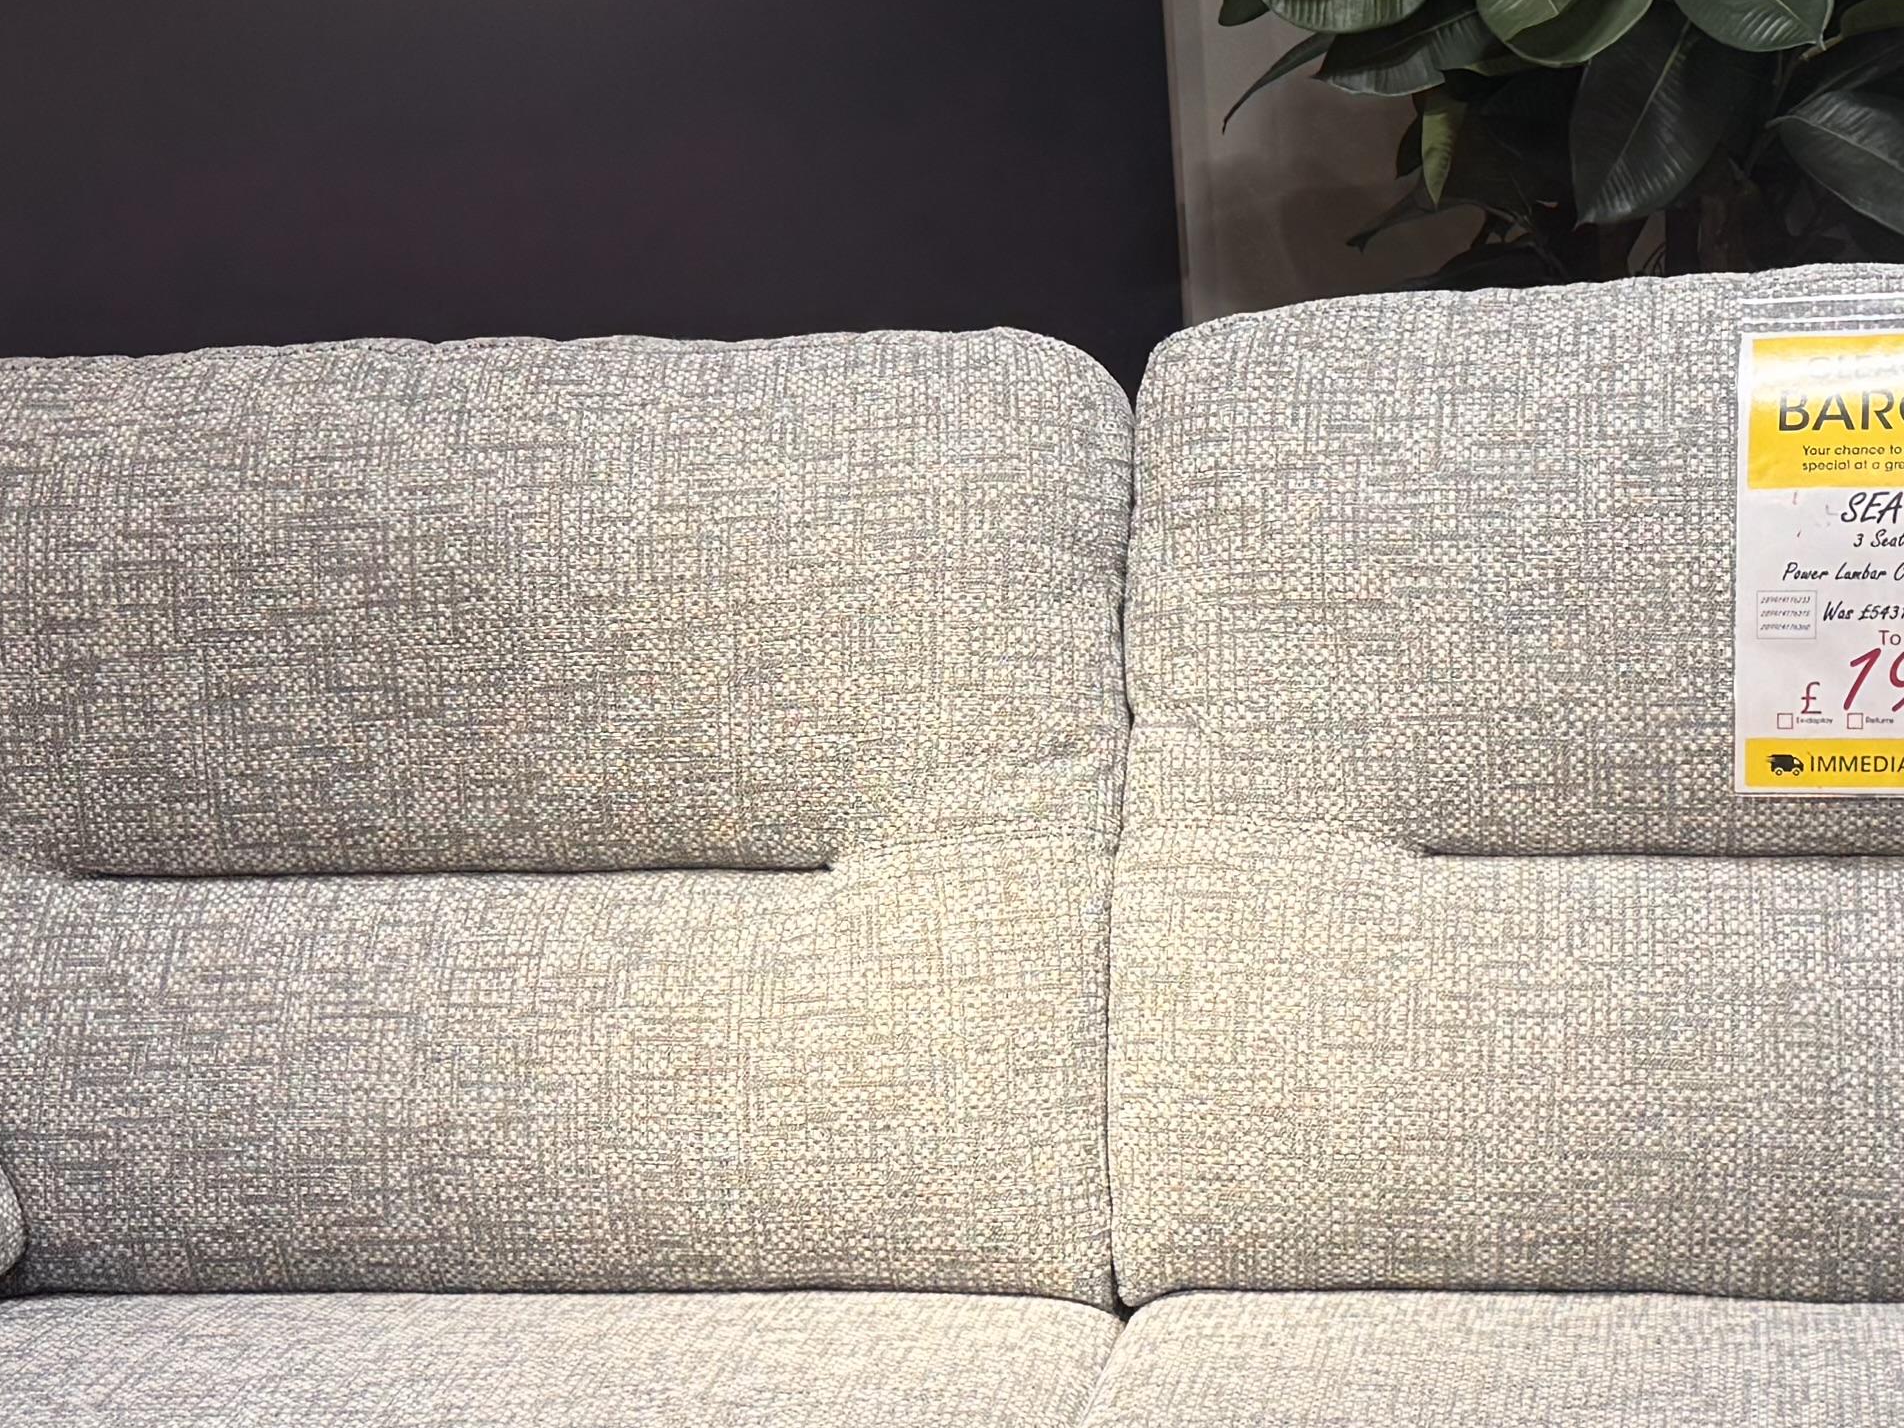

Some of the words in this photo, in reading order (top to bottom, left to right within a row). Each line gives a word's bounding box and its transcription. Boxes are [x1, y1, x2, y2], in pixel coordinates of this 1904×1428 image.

[1802, 445, 1830, 456] Your
[1834, 444, 1885, 455] chance
[1890, 444, 1902, 455] to
[1802, 459, 1850, 472] special
[1854, 459, 1867, 470] at
[1872, 461, 1880, 470] a
[1853, 532, 1865, 548] 3
[1783, 561, 1829, 581] Power
[1834, 561, 1887, 581] Lumbar
[1822, 600, 1855, 622] Was
[1878, 629, 1902, 646] To
[1801, 681, 1823, 715] £
